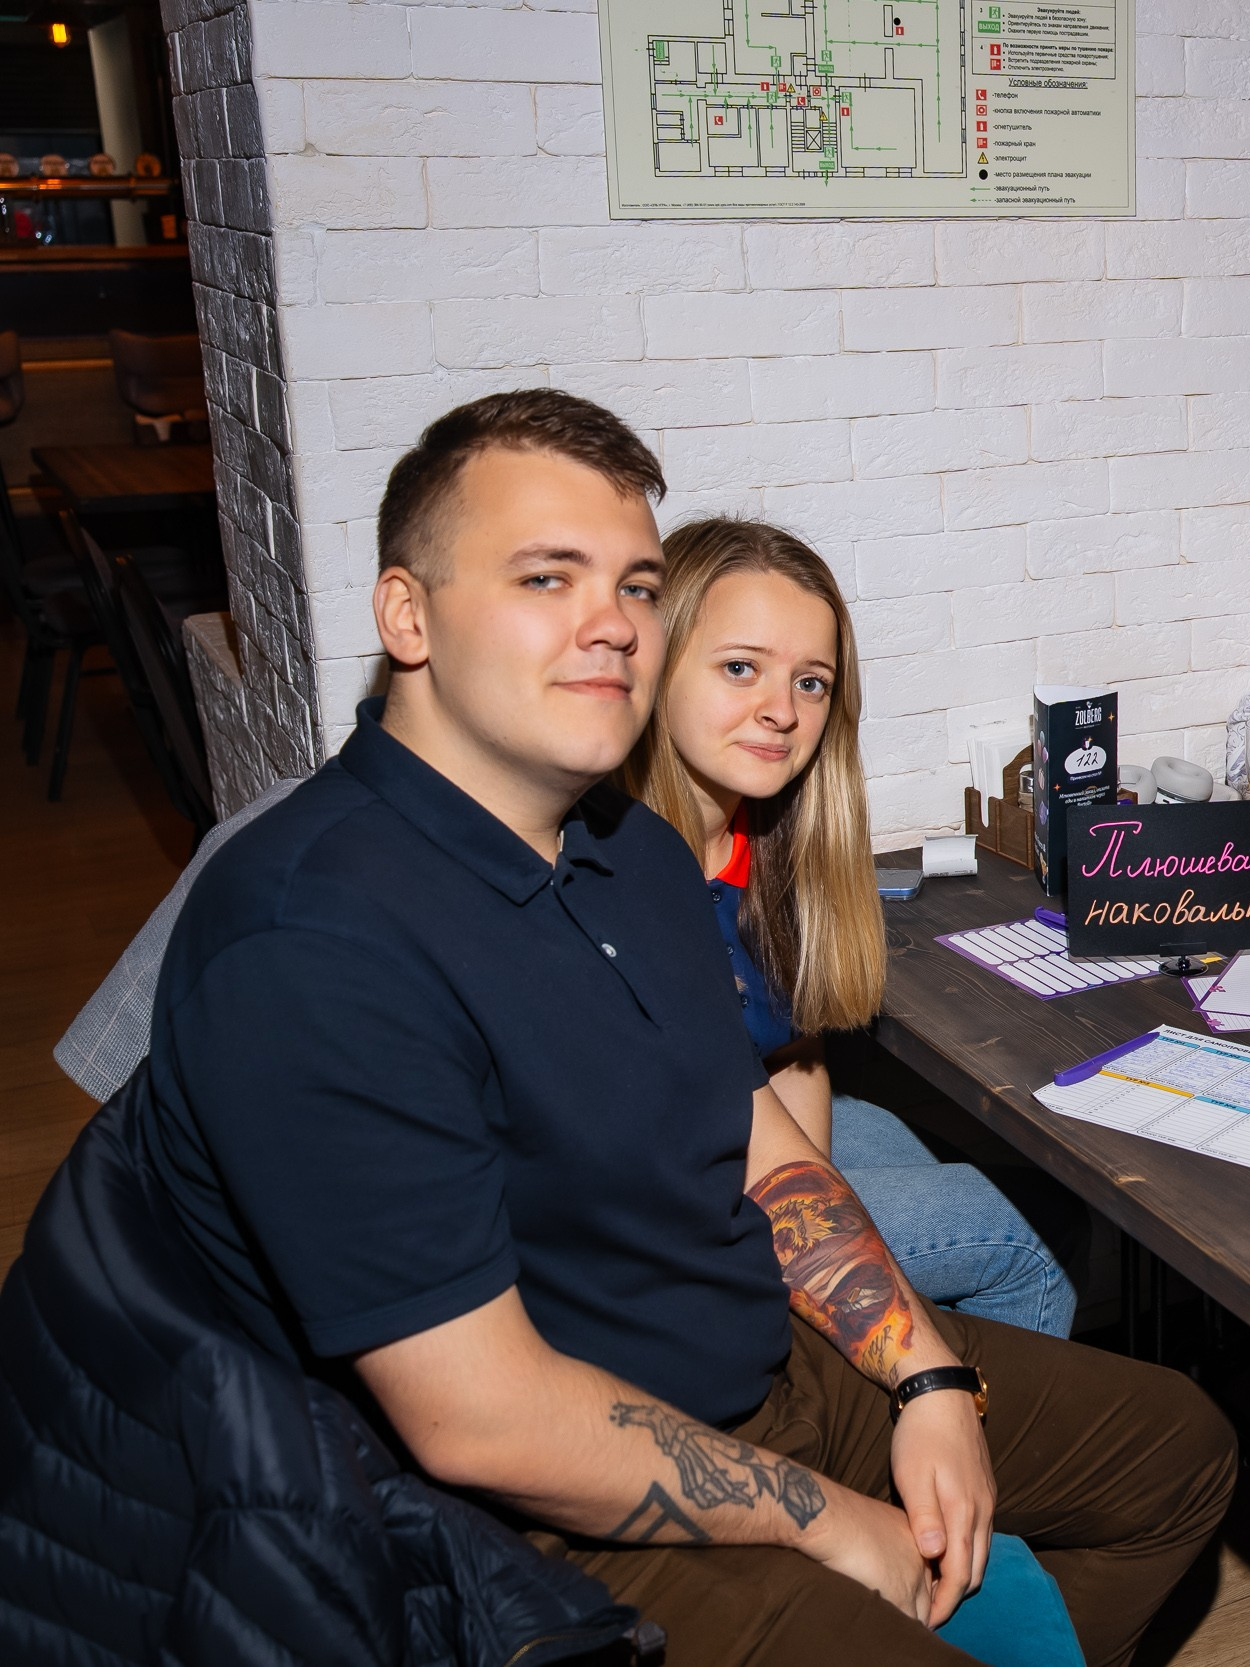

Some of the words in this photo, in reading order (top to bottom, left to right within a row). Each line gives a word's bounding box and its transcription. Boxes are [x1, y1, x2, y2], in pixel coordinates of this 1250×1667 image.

[979, 23, 1000, 31] ВЫХОД
[1008, 78, 1042, 87] Условные
[1043, 79, 1088, 89] обозначения:
[1044, 108, 1070, 116] пожарной
[1075, 707, 1102, 726] ZOLBERG
[1076, 752, 1098, 767] 122
[1163, 1029, 1186, 1037] ЛИСТ
